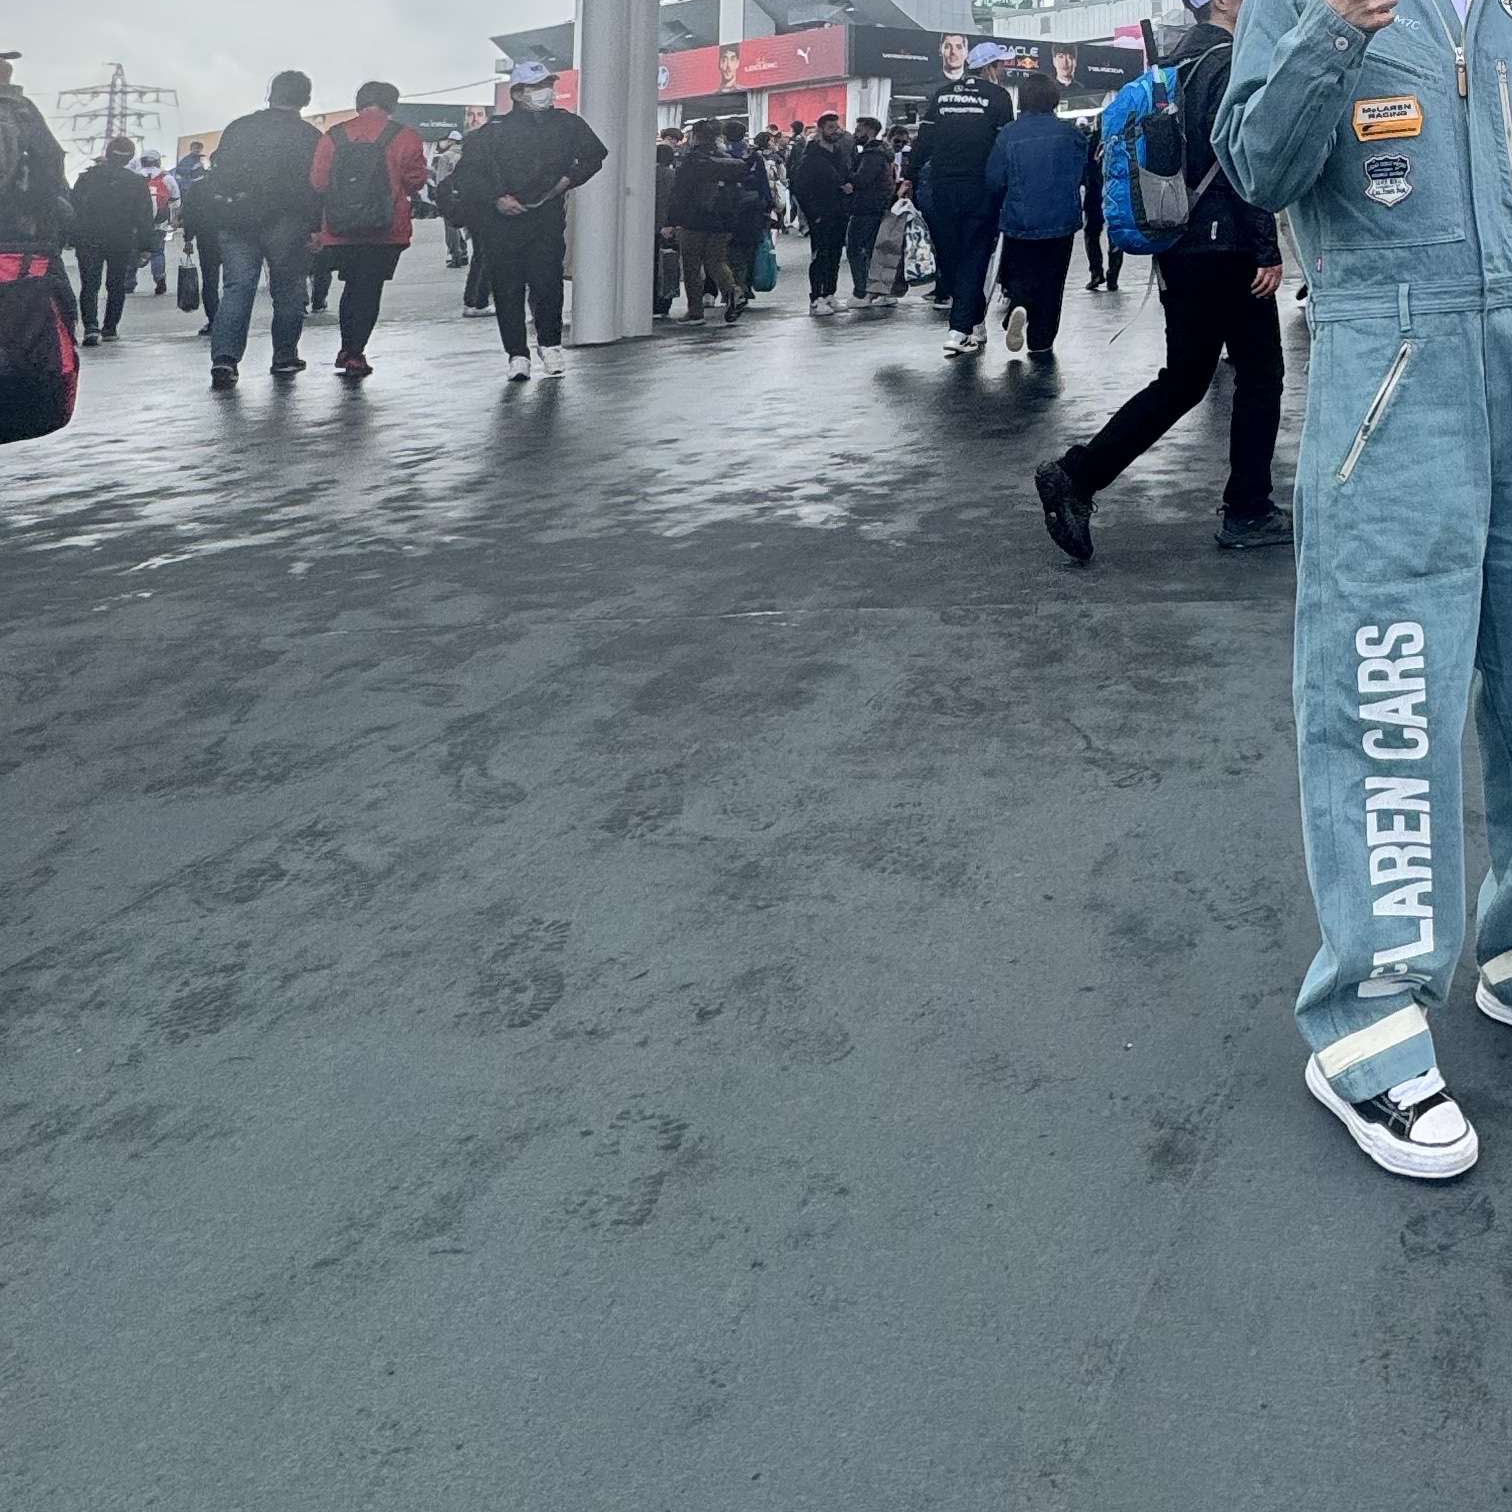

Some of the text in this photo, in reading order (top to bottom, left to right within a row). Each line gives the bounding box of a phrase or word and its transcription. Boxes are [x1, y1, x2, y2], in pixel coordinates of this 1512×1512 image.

[1393, 14, 1421, 30] M7C
[998, 44, 1039, 58] RACLE
[1355, 621, 1430, 760] CARS
